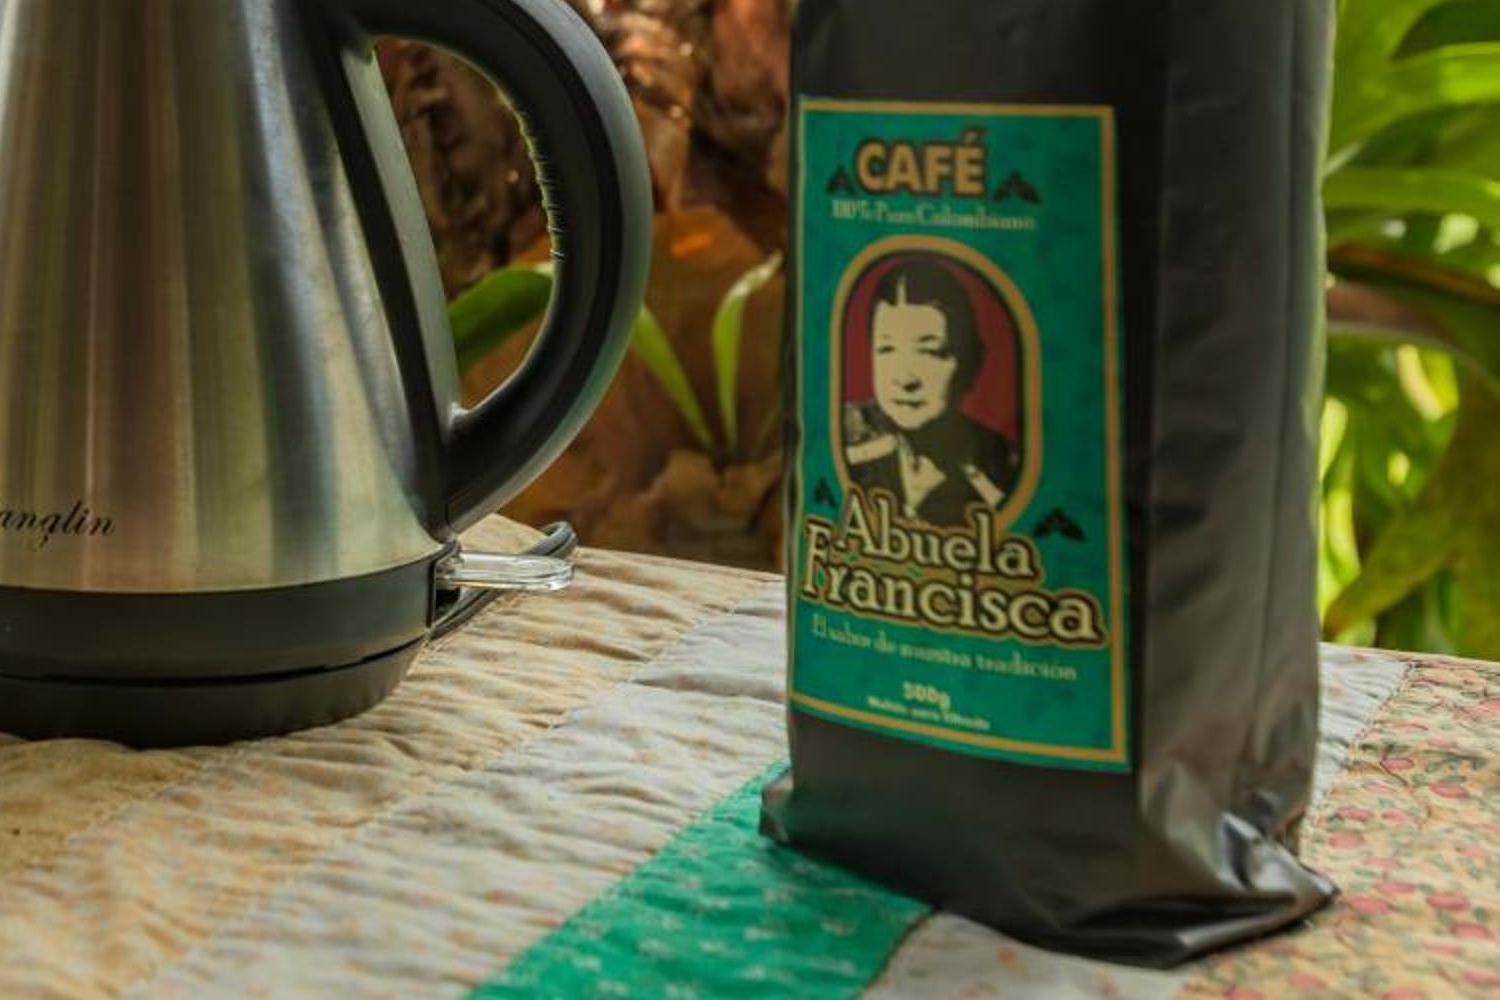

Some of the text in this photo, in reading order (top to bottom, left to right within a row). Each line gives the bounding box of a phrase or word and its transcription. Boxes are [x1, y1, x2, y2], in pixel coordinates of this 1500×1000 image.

[856, 130, 986, 196] CAFÉ
[836, 493, 1039, 577] Abuela
[802, 521, 1103, 640] Francisca
